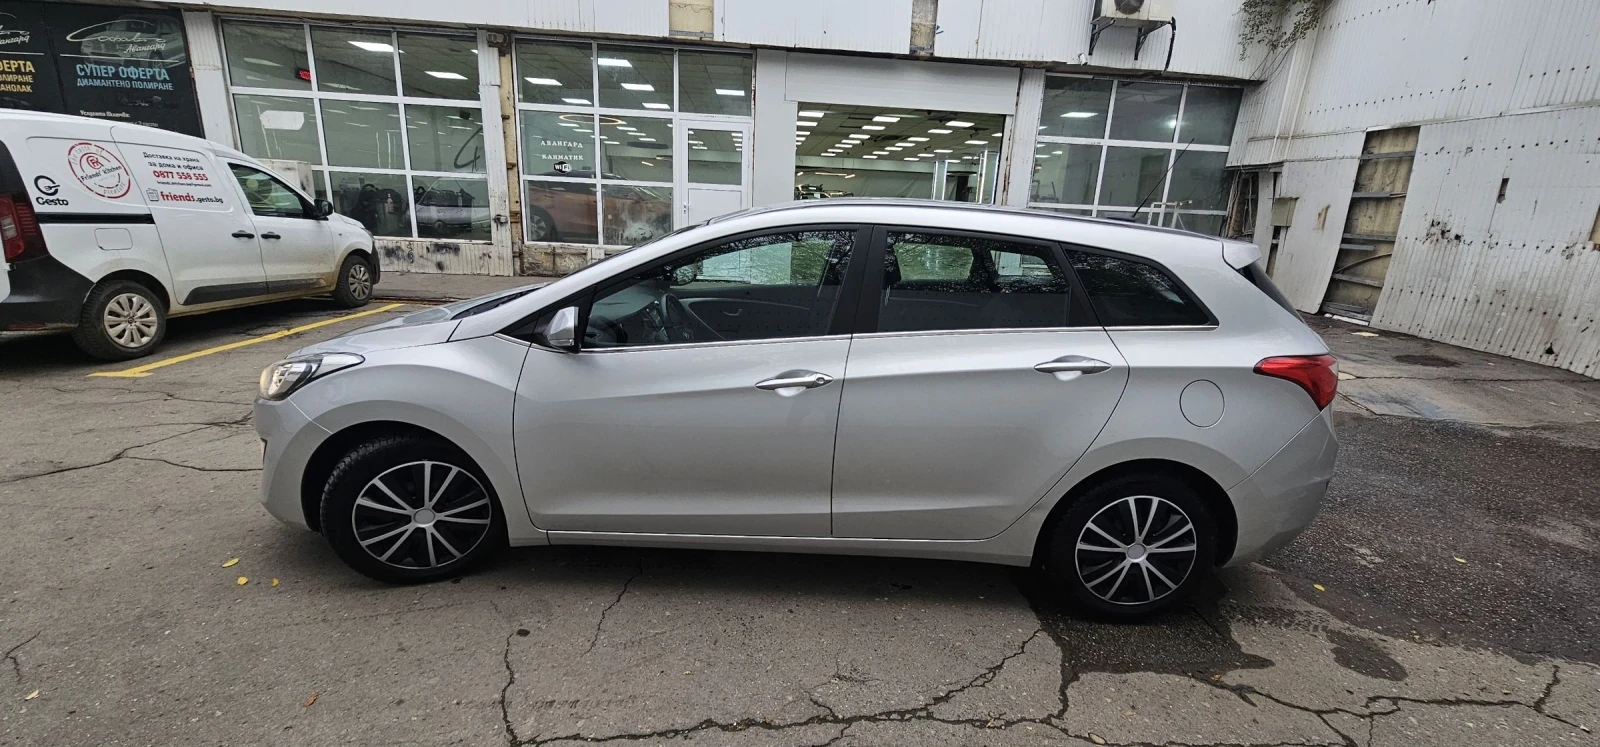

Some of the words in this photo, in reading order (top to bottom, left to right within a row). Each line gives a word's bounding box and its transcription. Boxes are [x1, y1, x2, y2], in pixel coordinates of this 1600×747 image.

[124, 43, 166, 53] Авангард
[76, 64, 115, 78] СУПЕР
[118, 66, 170, 80] ОФЕРТА
[0, 74, 34, 82] ЛИРАНЕ
[77, 78, 131, 88] ДИАМАНТЕНО
[132, 81, 174, 91] ПОЛИРАНЕ
[540, 140, 584, 148] АВАНГАРД
[142, 152, 173, 160] Доставка
[153, 170, 174, 179] 0877
[176, 172, 192, 180] 558
[193, 173, 208, 181] 555
[36, 196, 69, 206] Gesto
